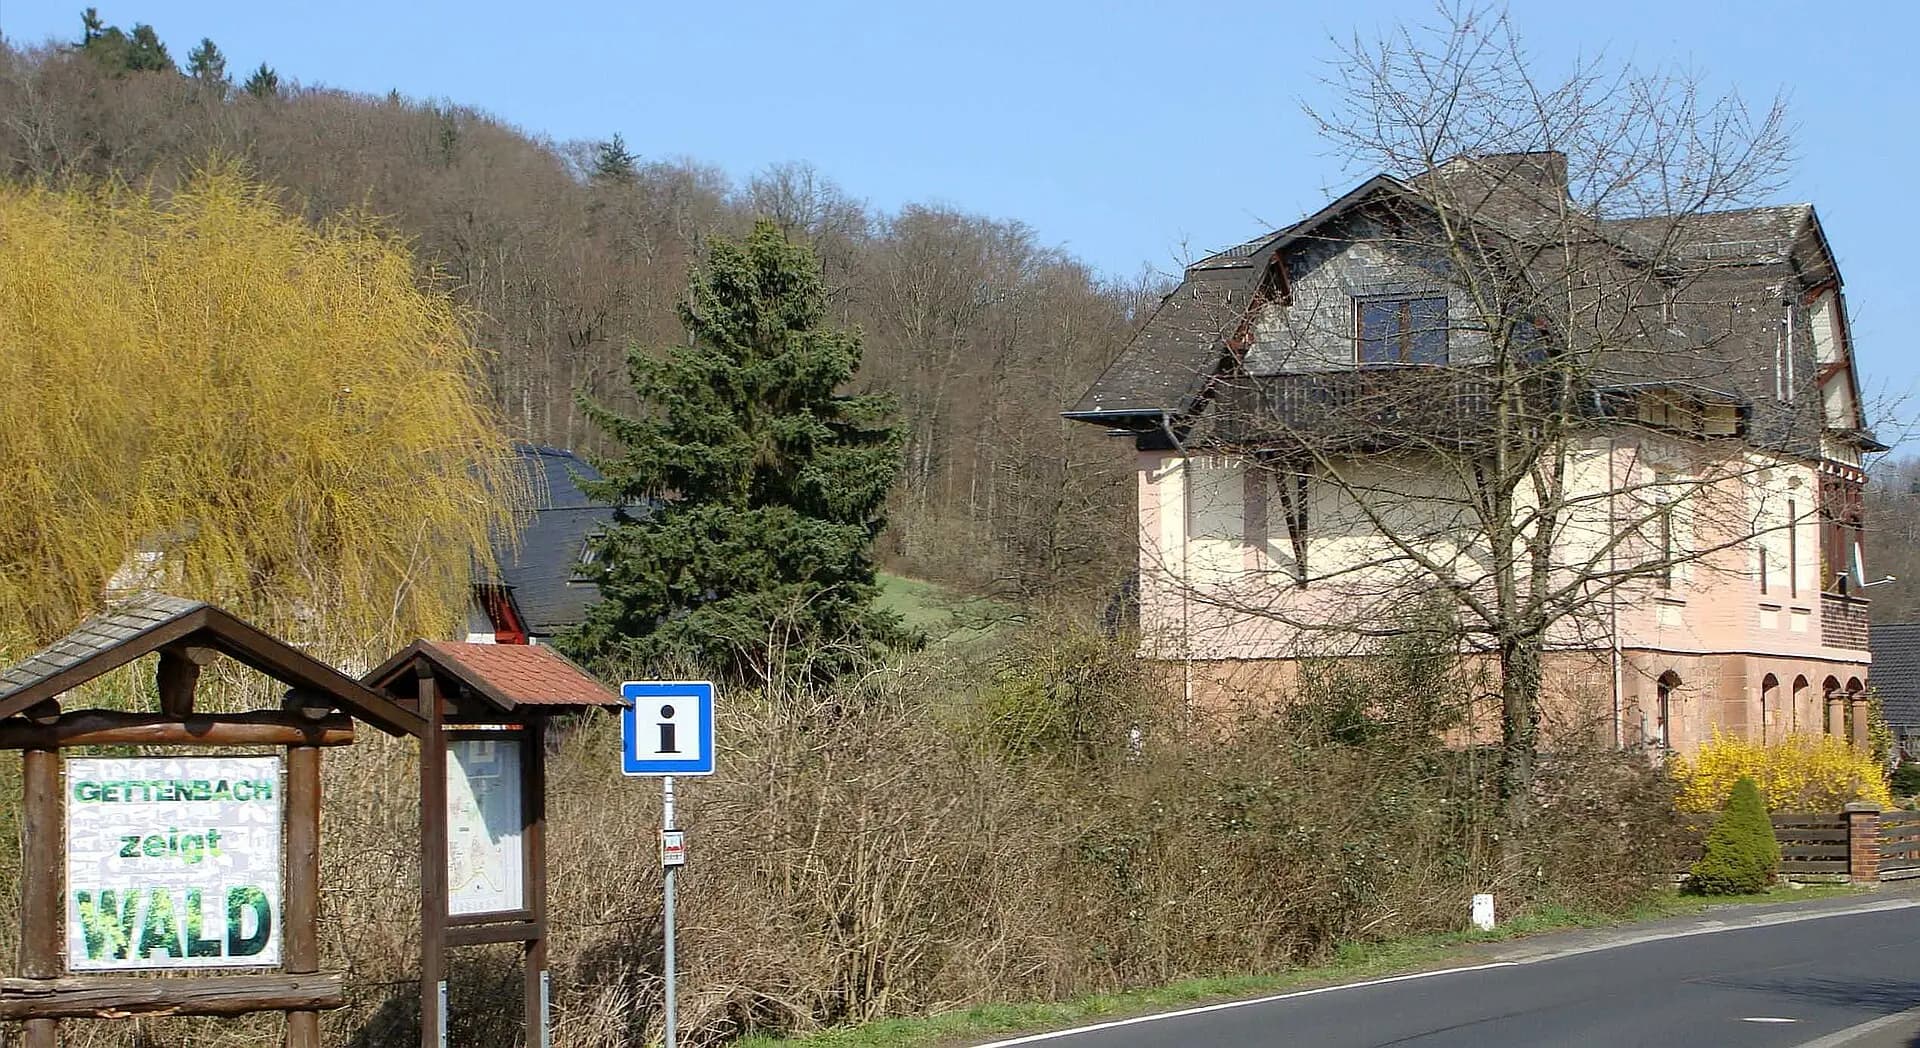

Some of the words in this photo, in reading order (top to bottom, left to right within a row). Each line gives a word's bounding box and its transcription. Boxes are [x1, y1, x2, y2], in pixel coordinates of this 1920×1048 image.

[73, 779, 273, 803] GETTENBACH
[119, 827, 222, 864] zeigt
[74, 885, 272, 960] WALD
